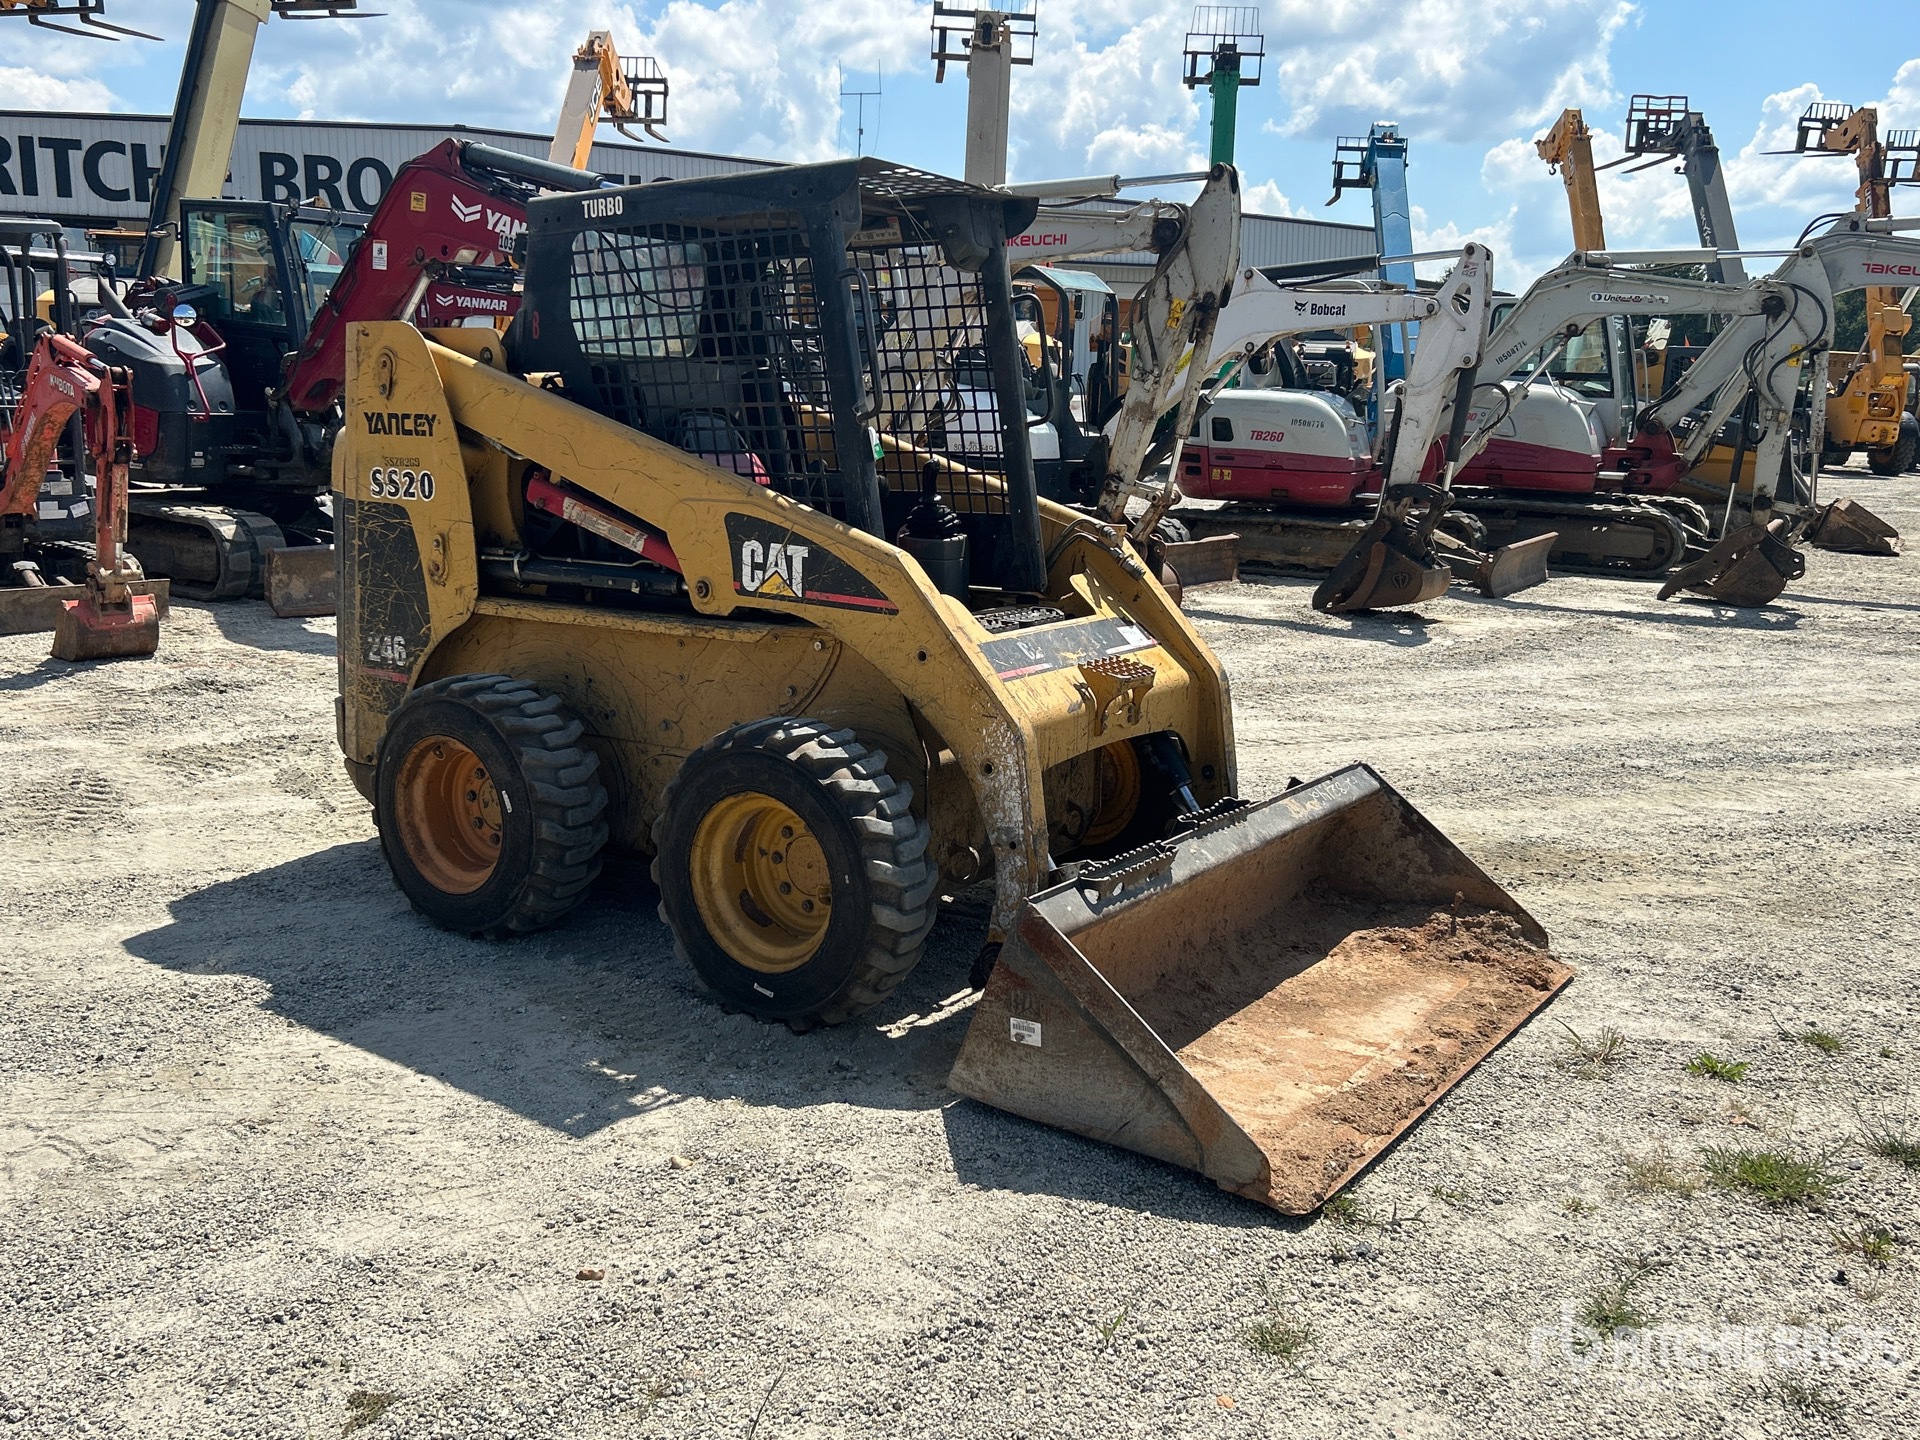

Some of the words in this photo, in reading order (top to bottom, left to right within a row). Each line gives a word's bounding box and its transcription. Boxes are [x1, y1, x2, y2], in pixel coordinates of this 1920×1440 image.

[582, 196, 624, 218] TURBO
[456, 296, 508, 311] YANMAR
[1310, 303, 1346, 316] Bobcat
[363, 411, 438, 437] YANCEY
[1250, 430, 1285, 442] TB260
[370, 467, 436, 502] SS20
[742, 539, 809, 598] CAT
[368, 633, 407, 666] 246
